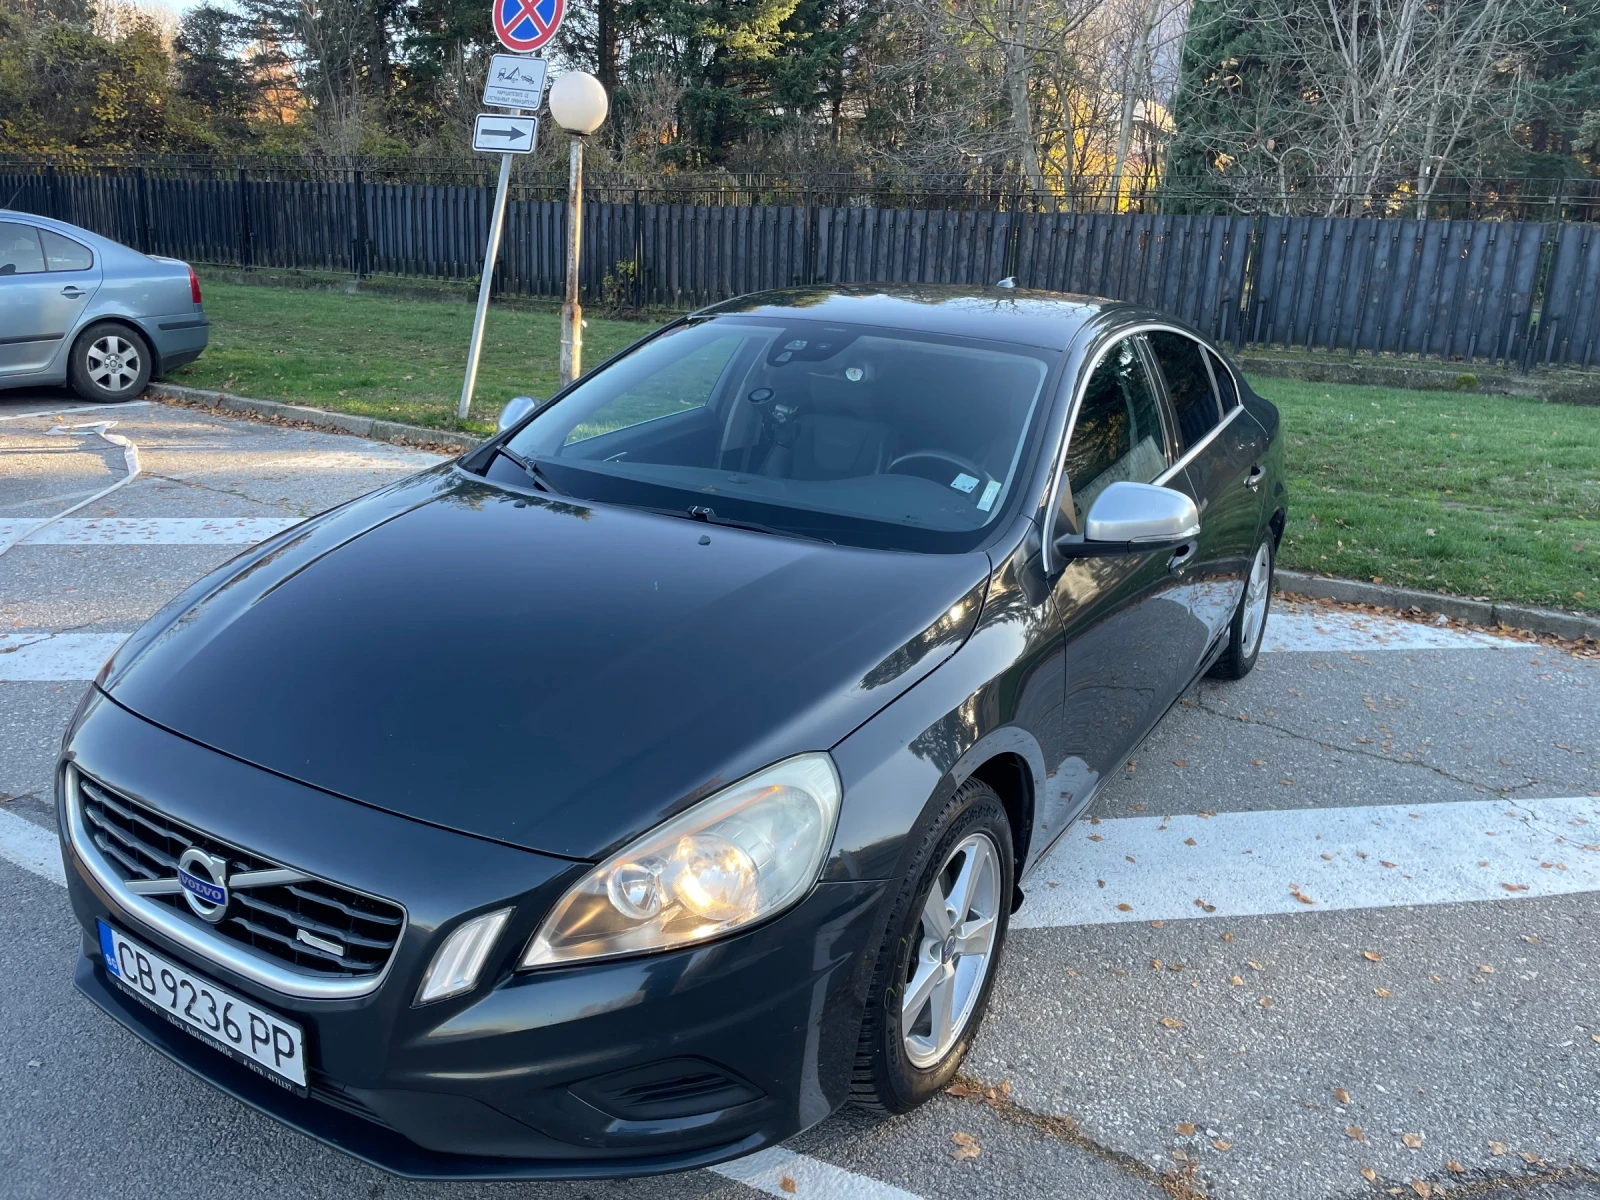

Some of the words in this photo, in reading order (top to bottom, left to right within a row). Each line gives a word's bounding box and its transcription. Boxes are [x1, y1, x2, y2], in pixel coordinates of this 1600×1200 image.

[181, 874, 222, 900] VOLVO
[105, 953, 118, 970] BG
[118, 941, 157, 996] CB
[160, 968, 243, 1044] 9236
[248, 1011, 295, 1069] PP
[166, 1013, 184, 1031] Alex
[185, 1024, 234, 1058] Automobile
